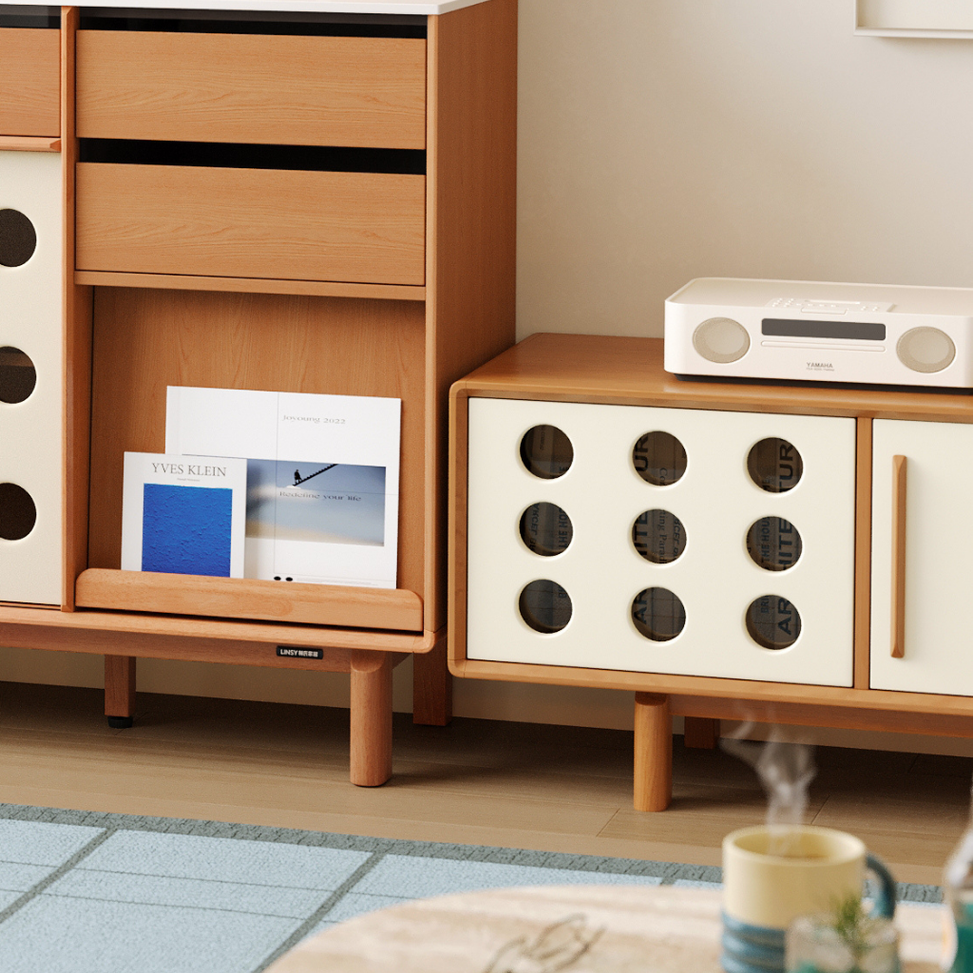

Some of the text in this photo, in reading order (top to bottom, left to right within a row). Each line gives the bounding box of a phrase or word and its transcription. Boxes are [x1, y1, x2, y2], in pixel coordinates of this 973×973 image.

[282, 414, 346, 425] Joyoung 2022
[151, 462, 227, 477] YVES KLEIN
[279, 491, 320, 499] Redefine
[280, 648, 298, 656] LINSY
